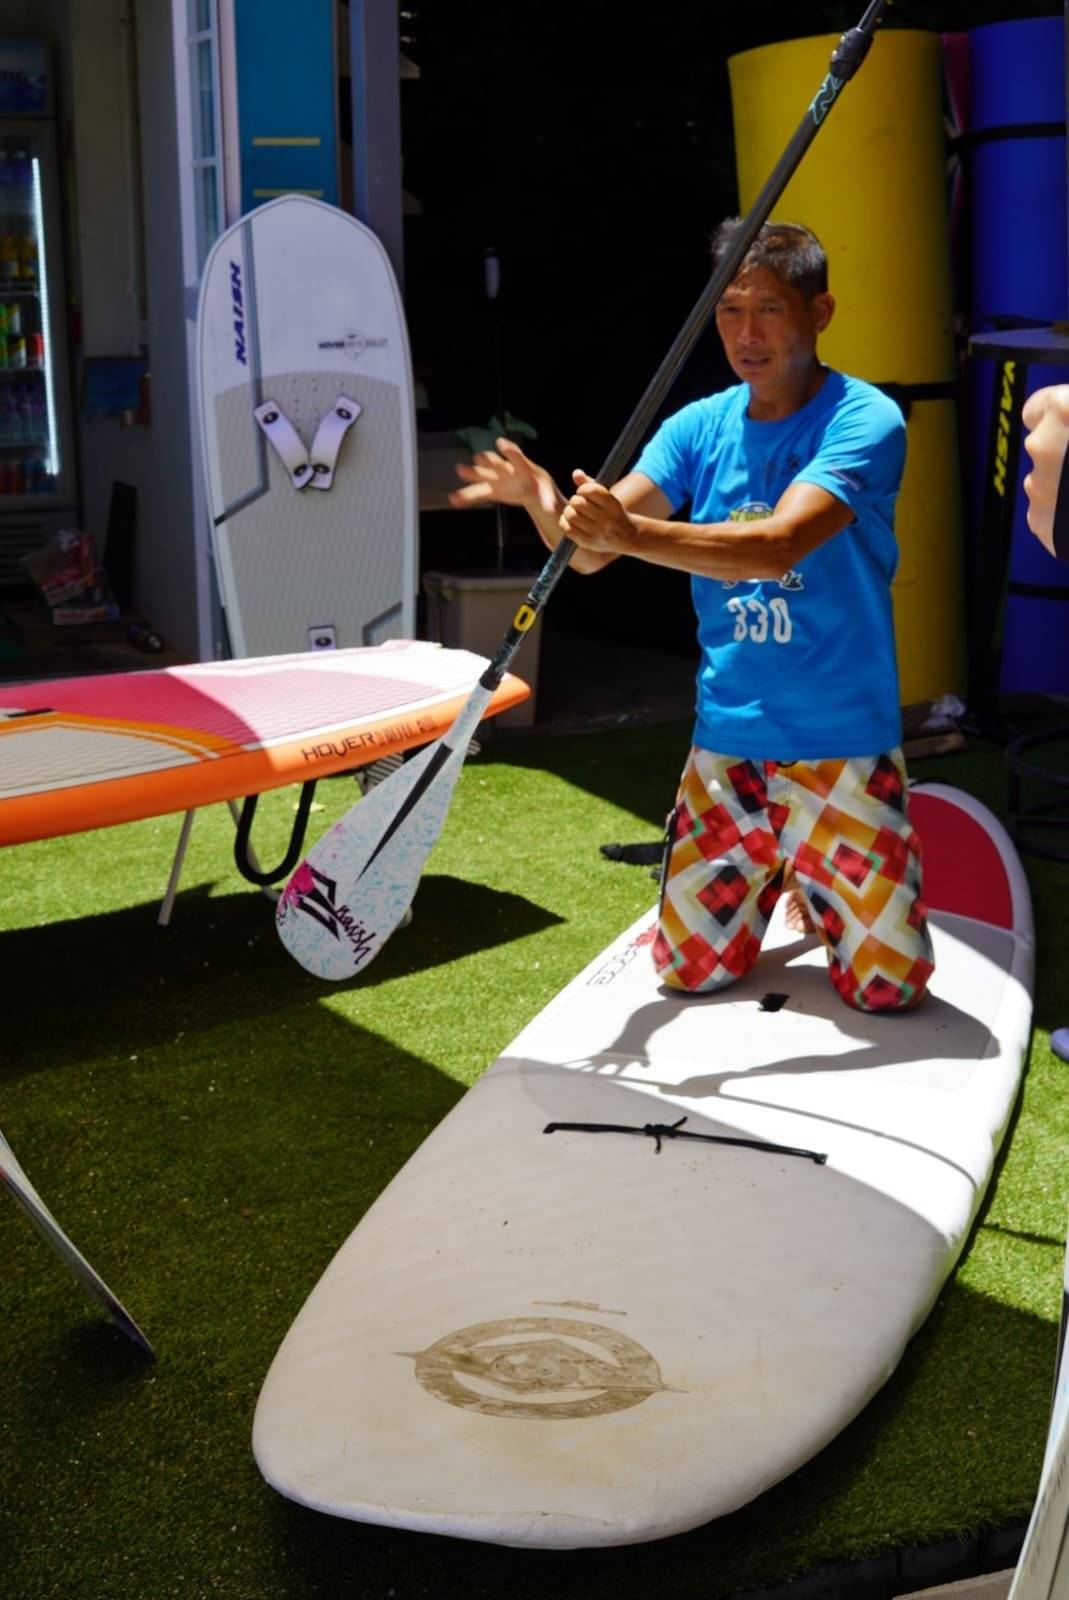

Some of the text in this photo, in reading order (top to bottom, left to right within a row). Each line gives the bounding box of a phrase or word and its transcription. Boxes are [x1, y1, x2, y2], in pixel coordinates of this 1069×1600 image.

[230, 261, 247, 365] NAISH
[993, 361, 1016, 497] NAISH
[728, 597, 793, 644] 330
[301, 732, 375, 761] HOVER
